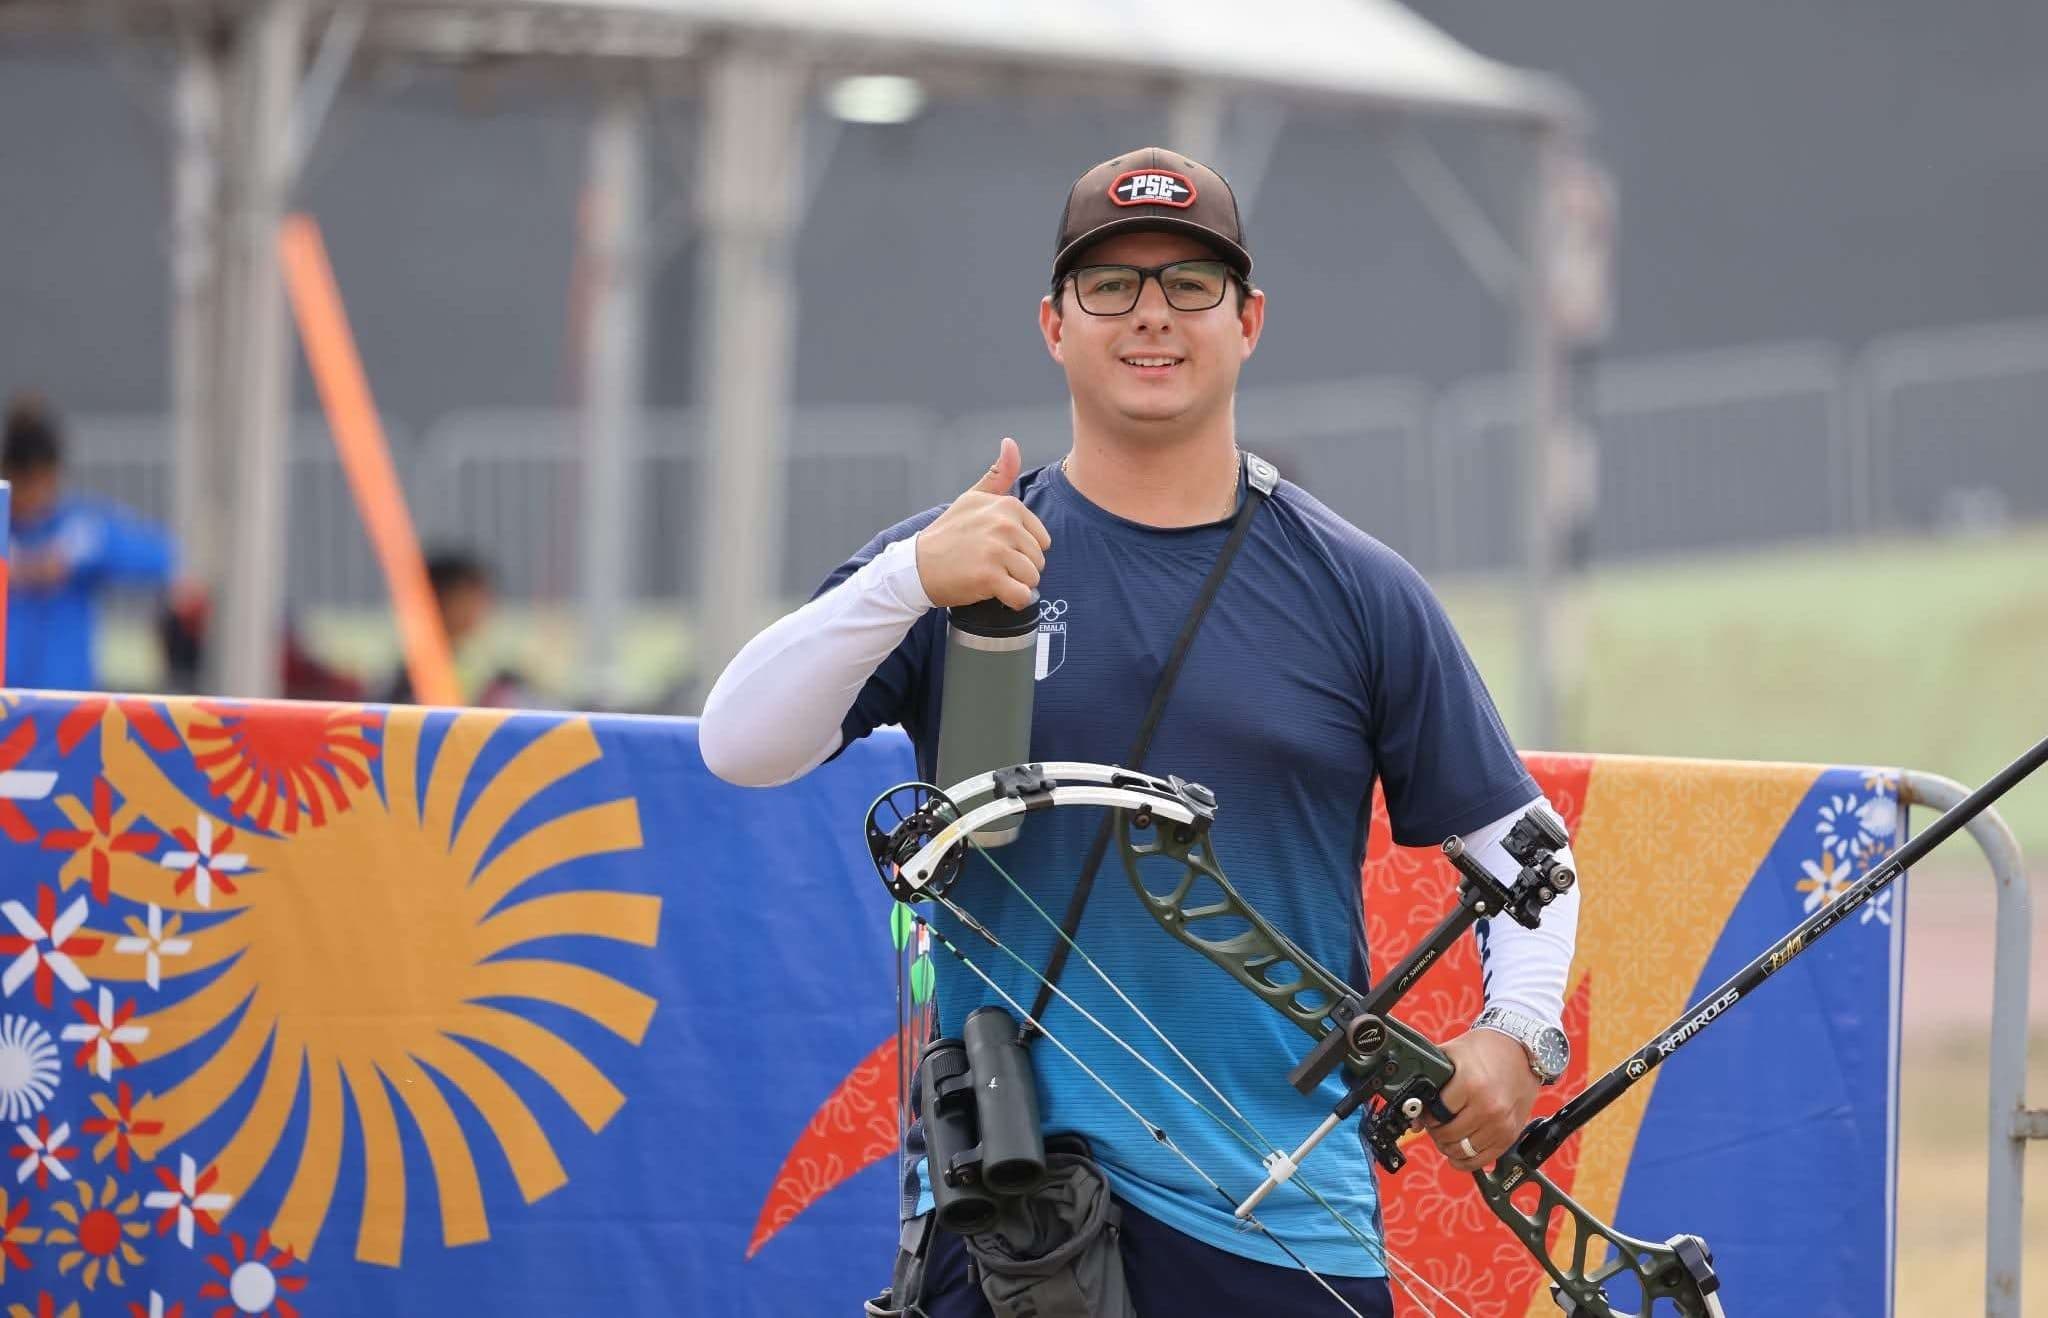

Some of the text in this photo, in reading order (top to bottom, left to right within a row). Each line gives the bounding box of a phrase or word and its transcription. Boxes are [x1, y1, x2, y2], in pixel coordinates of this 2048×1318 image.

[1131, 175, 1174, 197] PSE
[1039, 624, 1064, 632] EMALA
[1656, 987, 1740, 1057] RAMRODS
